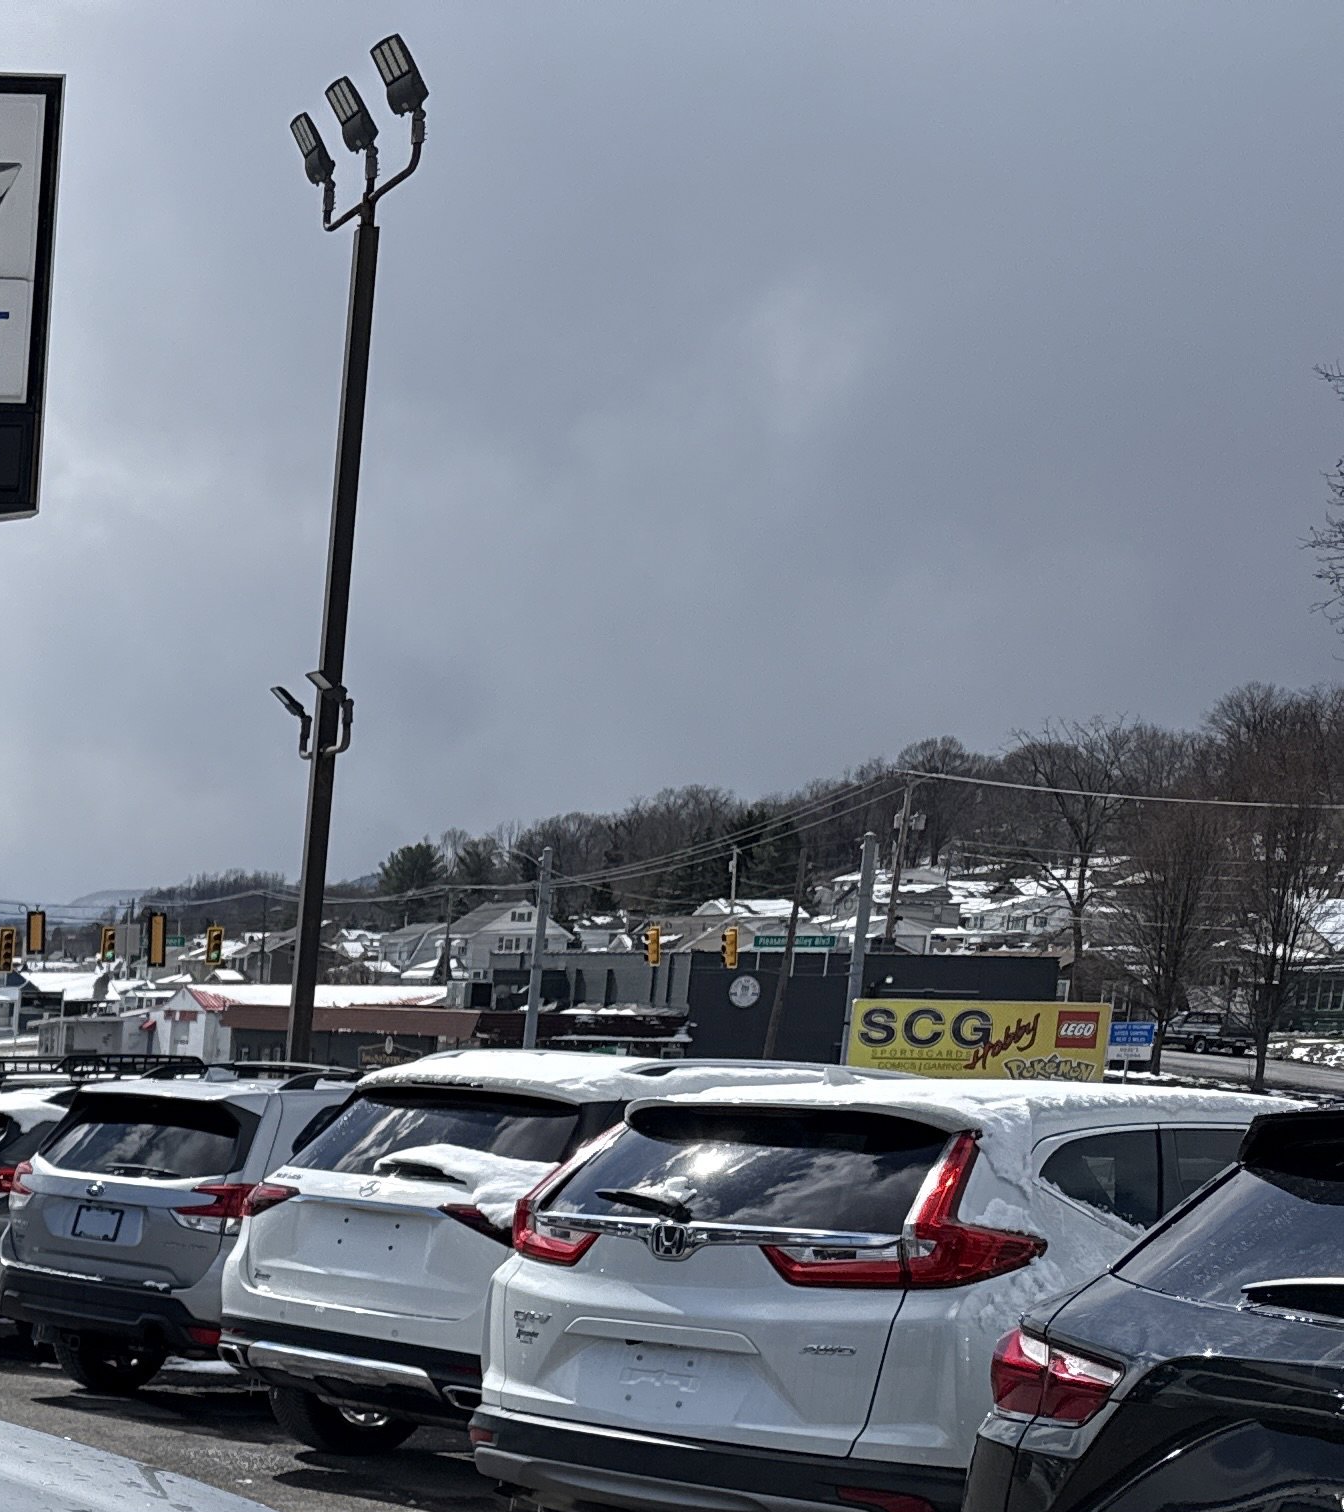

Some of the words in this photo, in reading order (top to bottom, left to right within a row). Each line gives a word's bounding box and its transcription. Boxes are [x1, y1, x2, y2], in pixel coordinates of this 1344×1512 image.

[1060, 1021, 1097, 1038] LEGO
[857, 1007, 994, 1049] SCG
[963, 1012, 1041, 1070] Hobby
[871, 1049, 973, 1060] SPORTSCARDS
